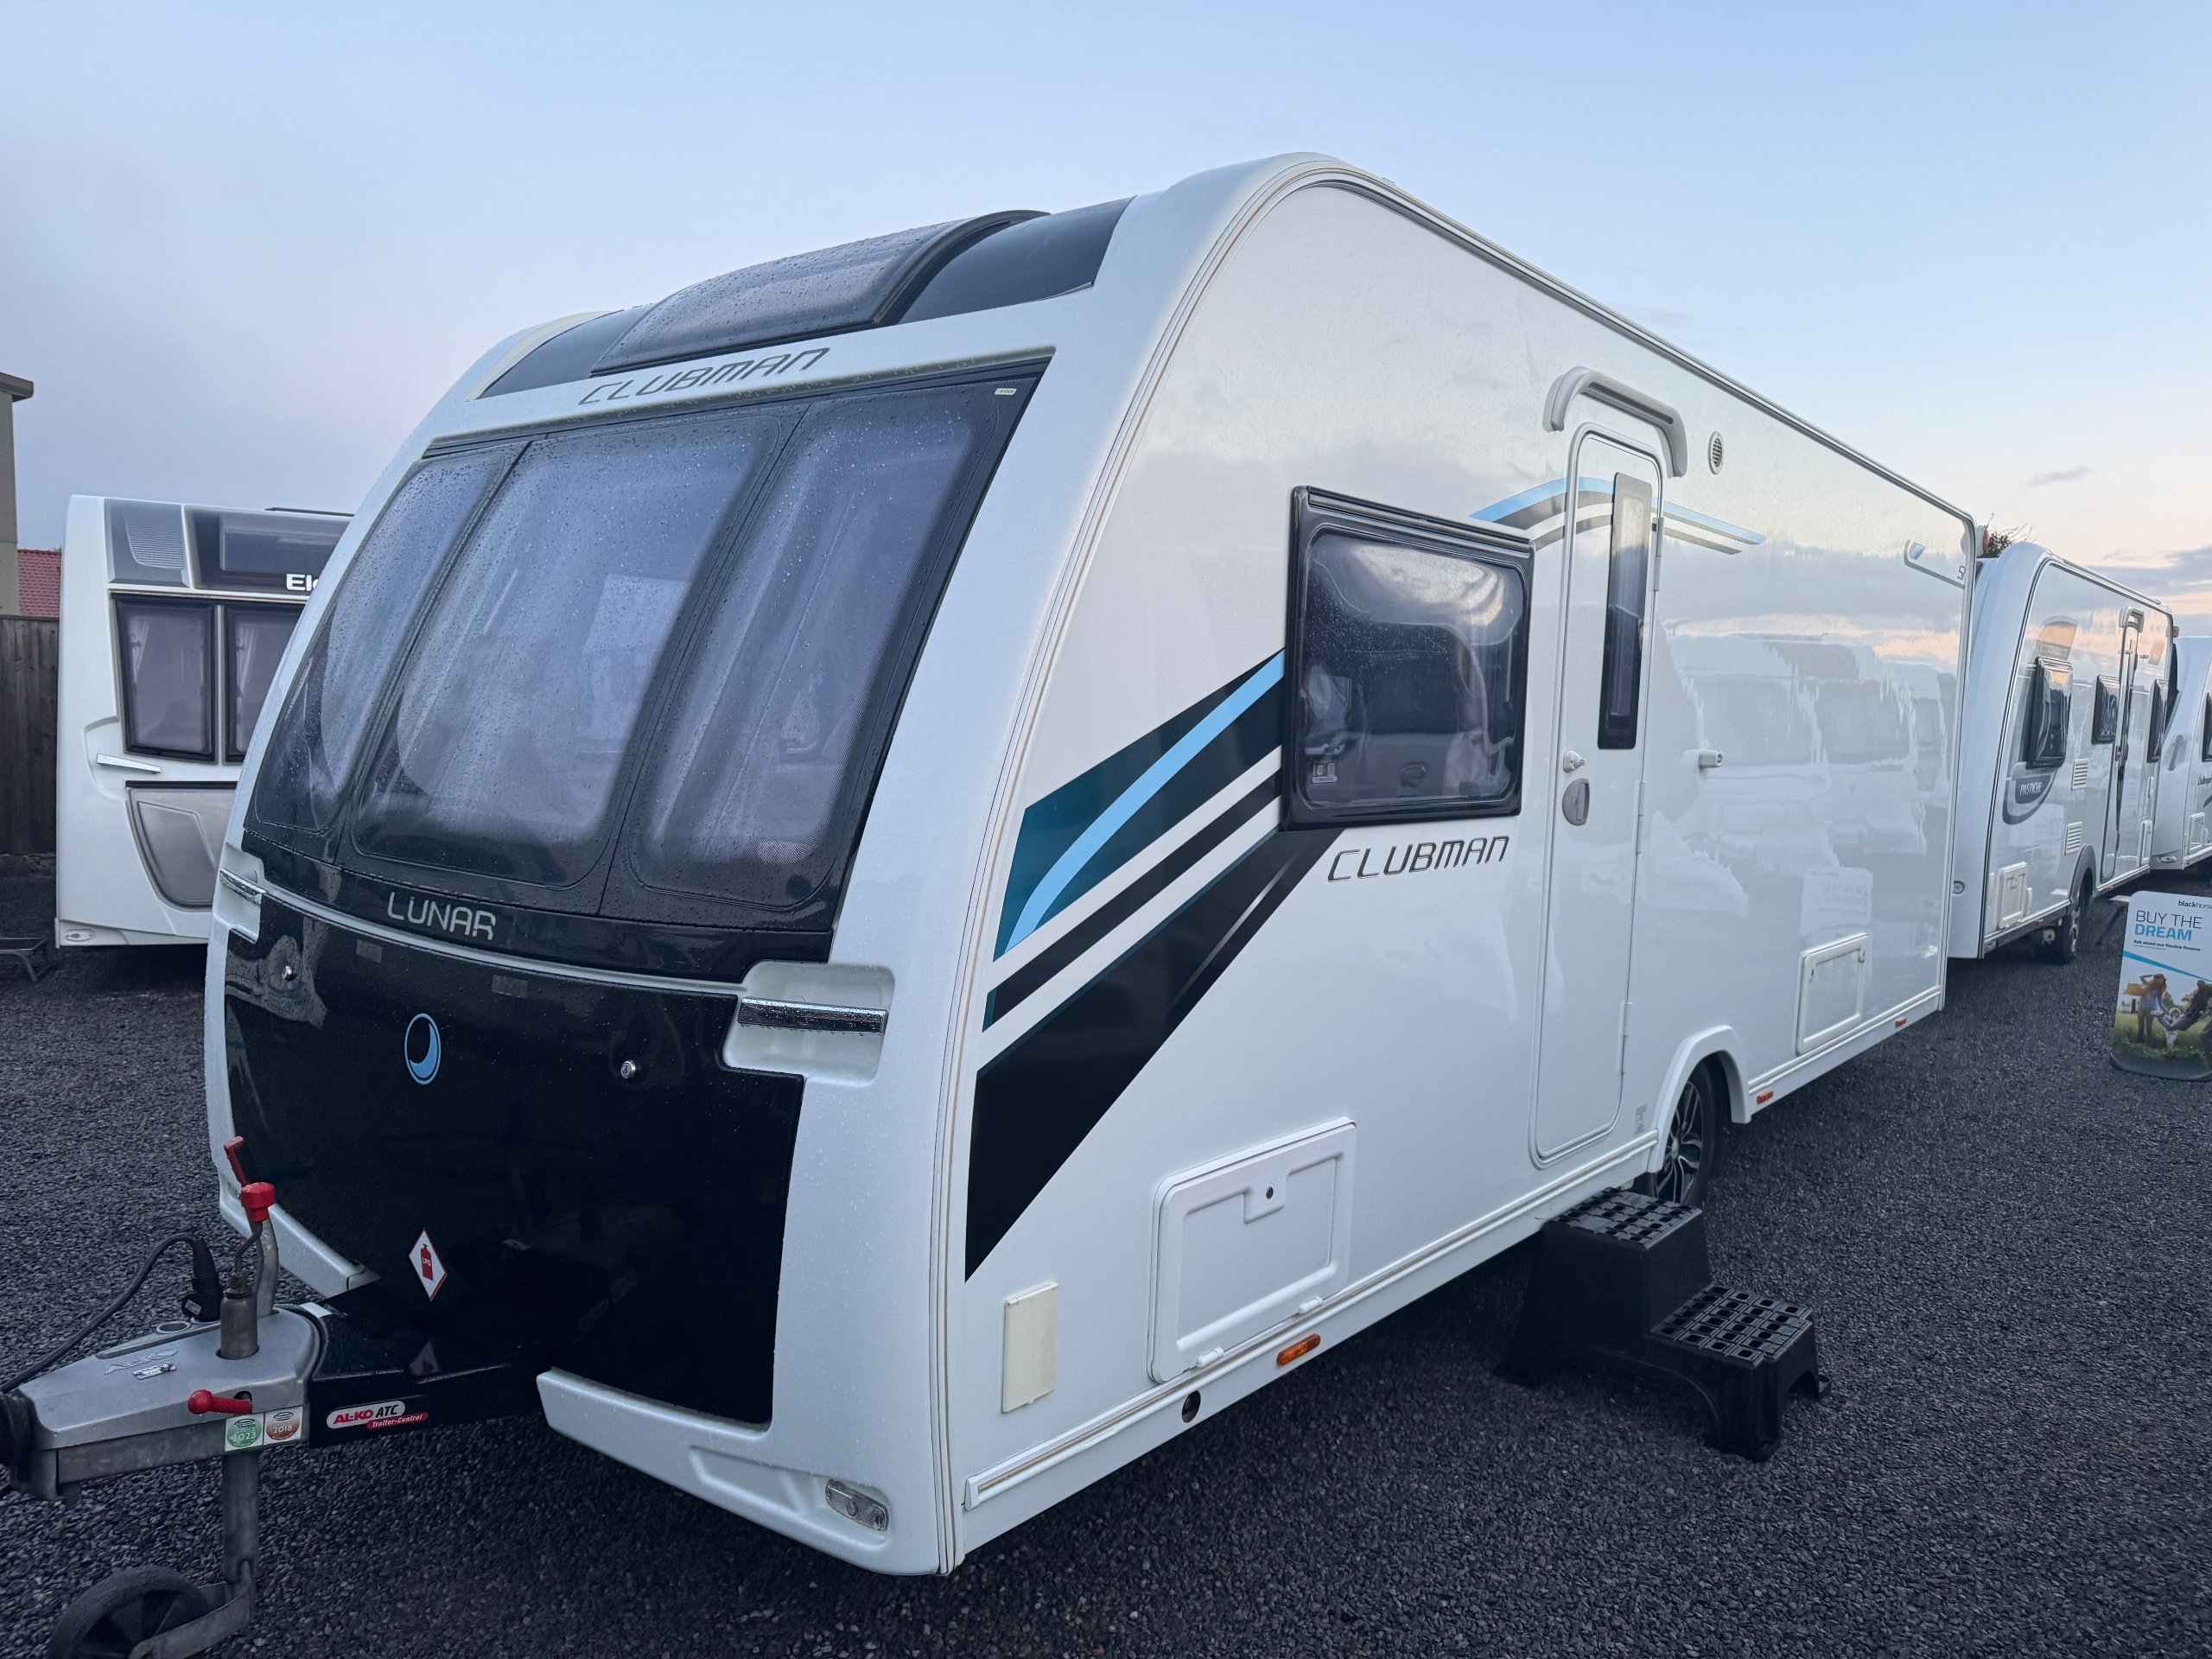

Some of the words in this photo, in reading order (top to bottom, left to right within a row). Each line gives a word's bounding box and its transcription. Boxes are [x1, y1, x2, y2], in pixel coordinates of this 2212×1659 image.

[578, 347, 830, 405] CLUBMAN
[1327, 836, 1510, 882] CLUBMAN
[387, 891, 497, 941] LUNAR
[2135, 910, 2167, 925] BUY
[2171, 913, 2203, 929] THE
[2134, 924, 2192, 942] DREAM
[334, 1409, 374, 1424] AL-KO
[375, 1404, 399, 1418] ATC
[372, 1414, 423, 1428] Trailer-Control
[232, 1431, 257, 1441] 023
[273, 1424, 293, 1433] 2018
